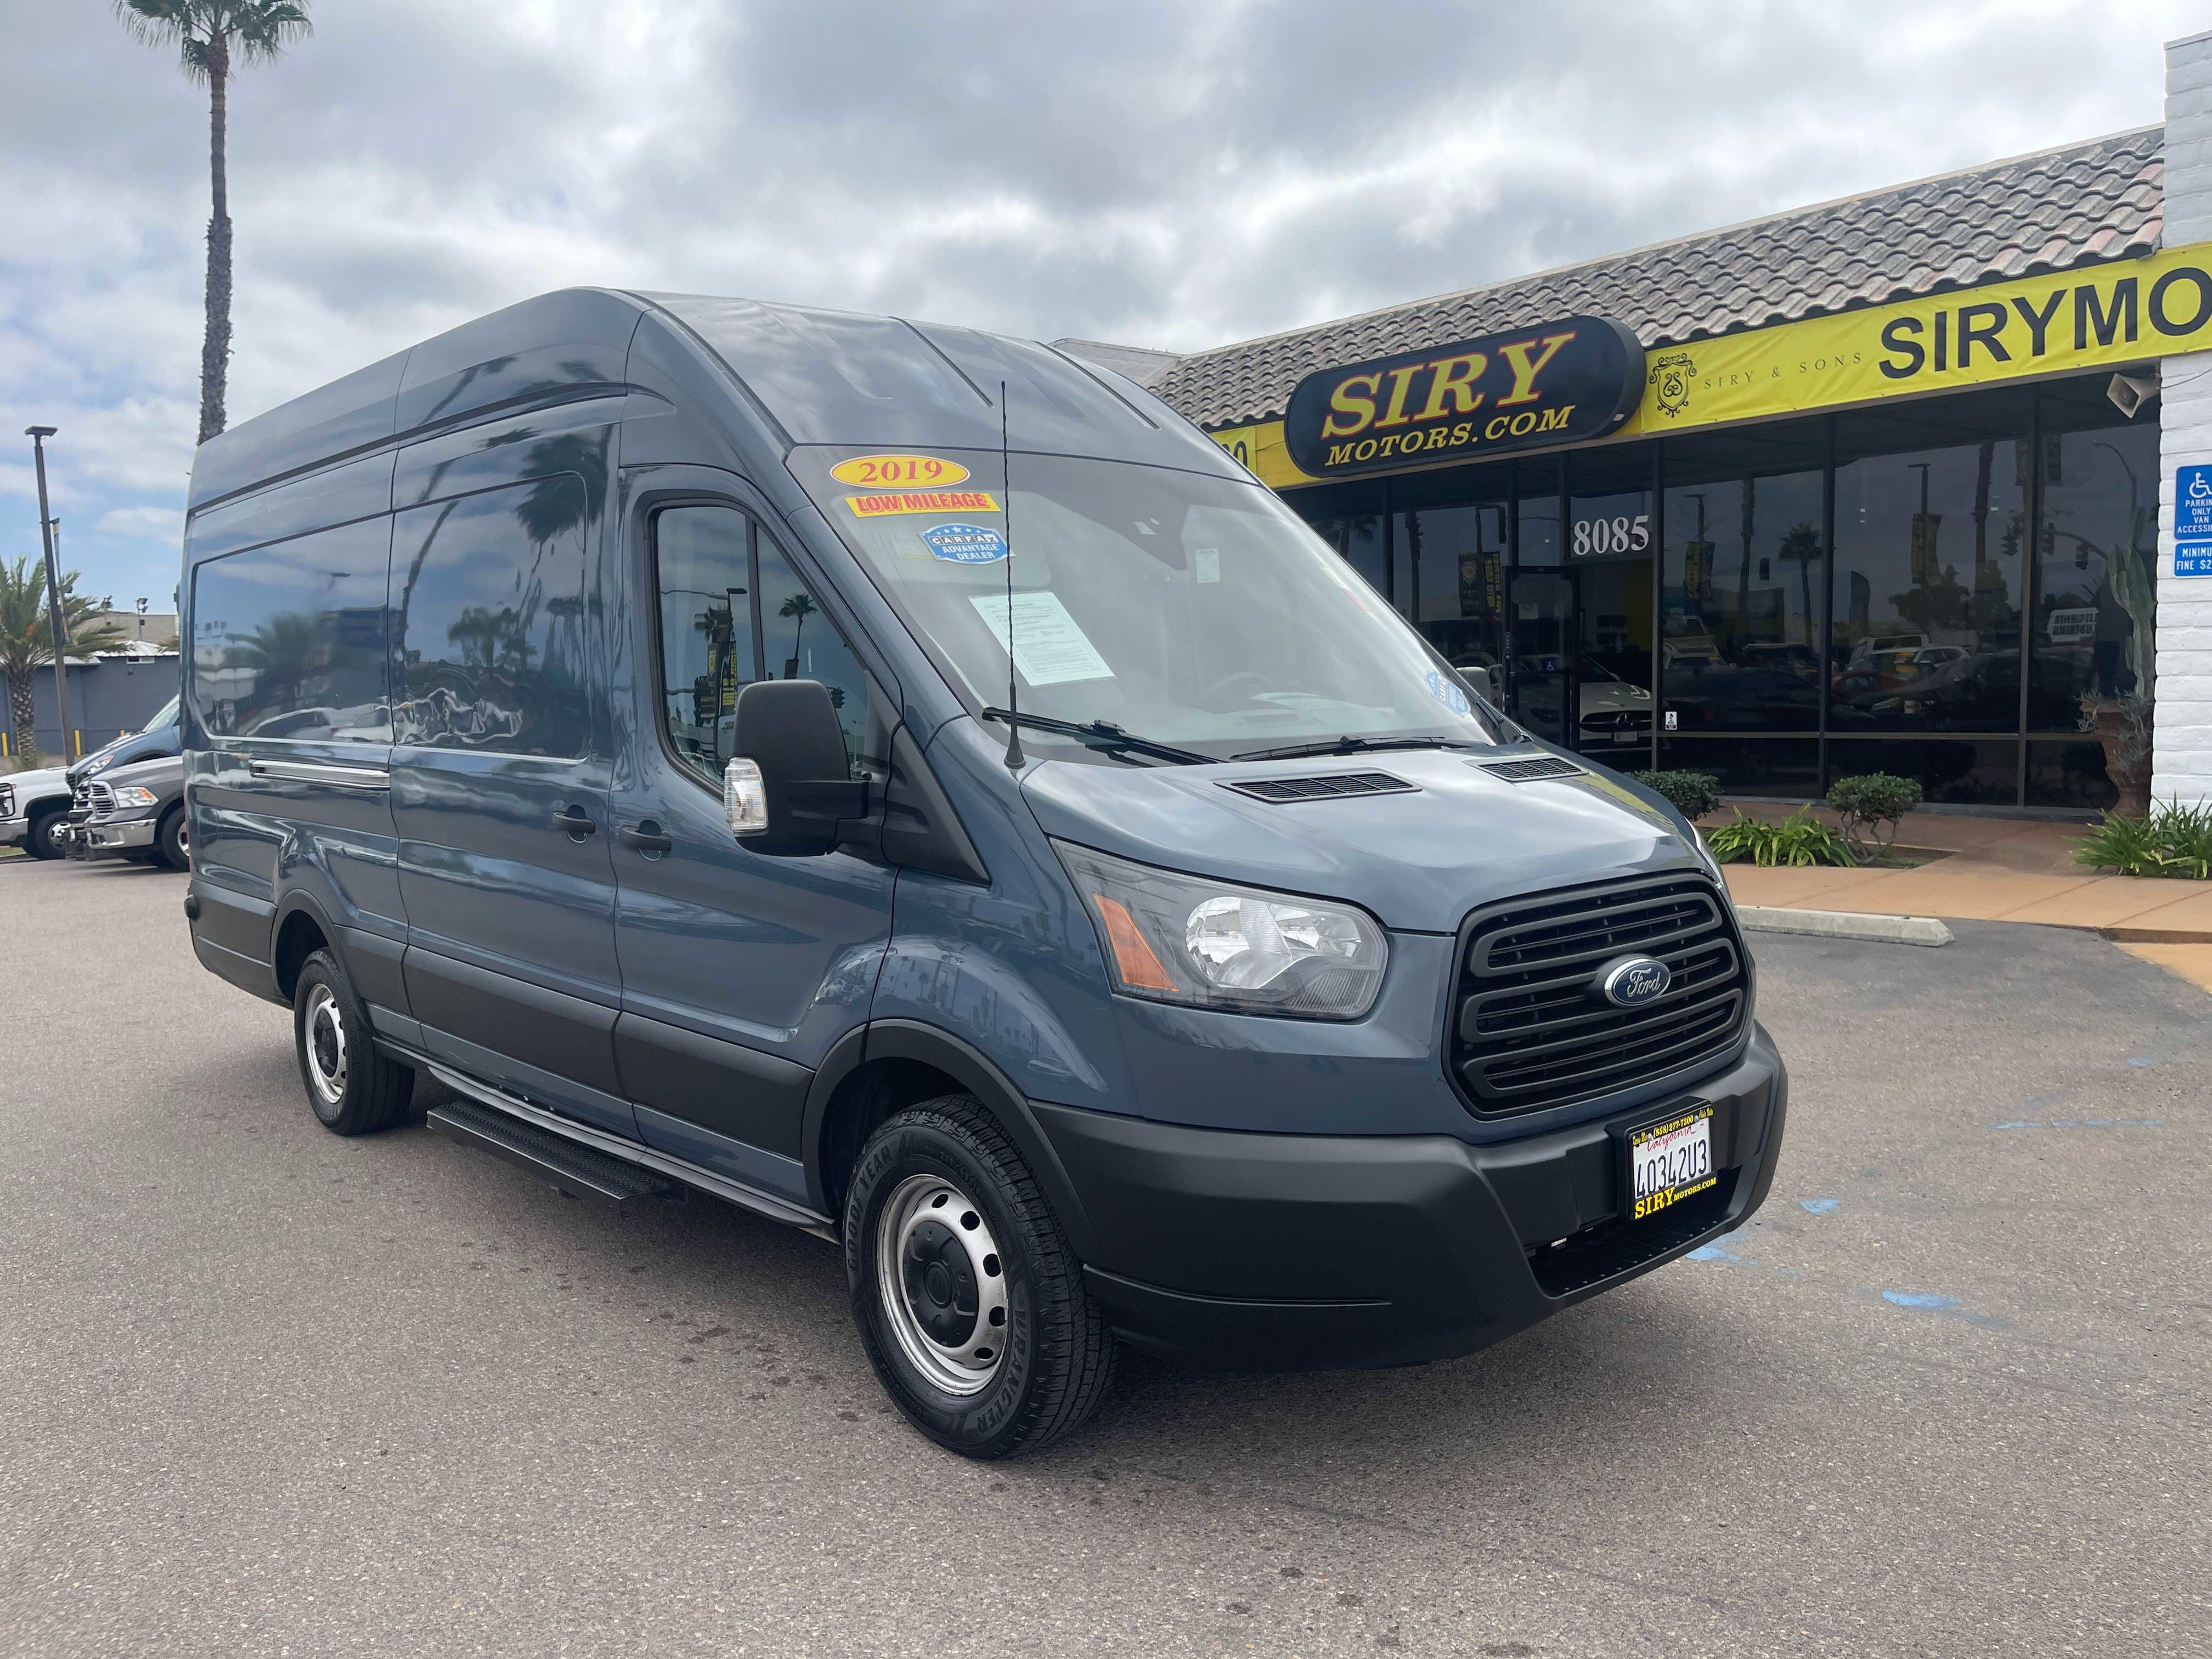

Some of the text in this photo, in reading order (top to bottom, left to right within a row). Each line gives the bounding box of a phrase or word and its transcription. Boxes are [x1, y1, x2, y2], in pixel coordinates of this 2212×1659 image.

[1704, 267, 2212, 390] SIRY & SONS SIRYMO
[1321, 330, 1577, 439] SIRY
[1324, 405, 1576, 467] MOTORS.COM
[859, 460, 943, 483] 2019
[856, 493, 990, 514] LOW MILEAGE
[2192, 507, 2211, 516] ONLY
[2177, 524, 2212, 533] ACCESSI
[2194, 516, 2209, 524] VAN
[931, 534, 1000, 545] CARFAX
[1573, 515, 1650, 556] 8085
[942, 544, 1000, 554] ADVANTAGE
[956, 552, 996, 560] DEALER
[2177, 560, 2194, 571] FINE
[1627, 967, 1661, 998] Ford
[1637, 1139, 1707, 1198] 40342U3
[1635, 1177, 1717, 1220] SIRY MOTORS.COM
[977, 1310, 1026, 1434] WRANGLER
